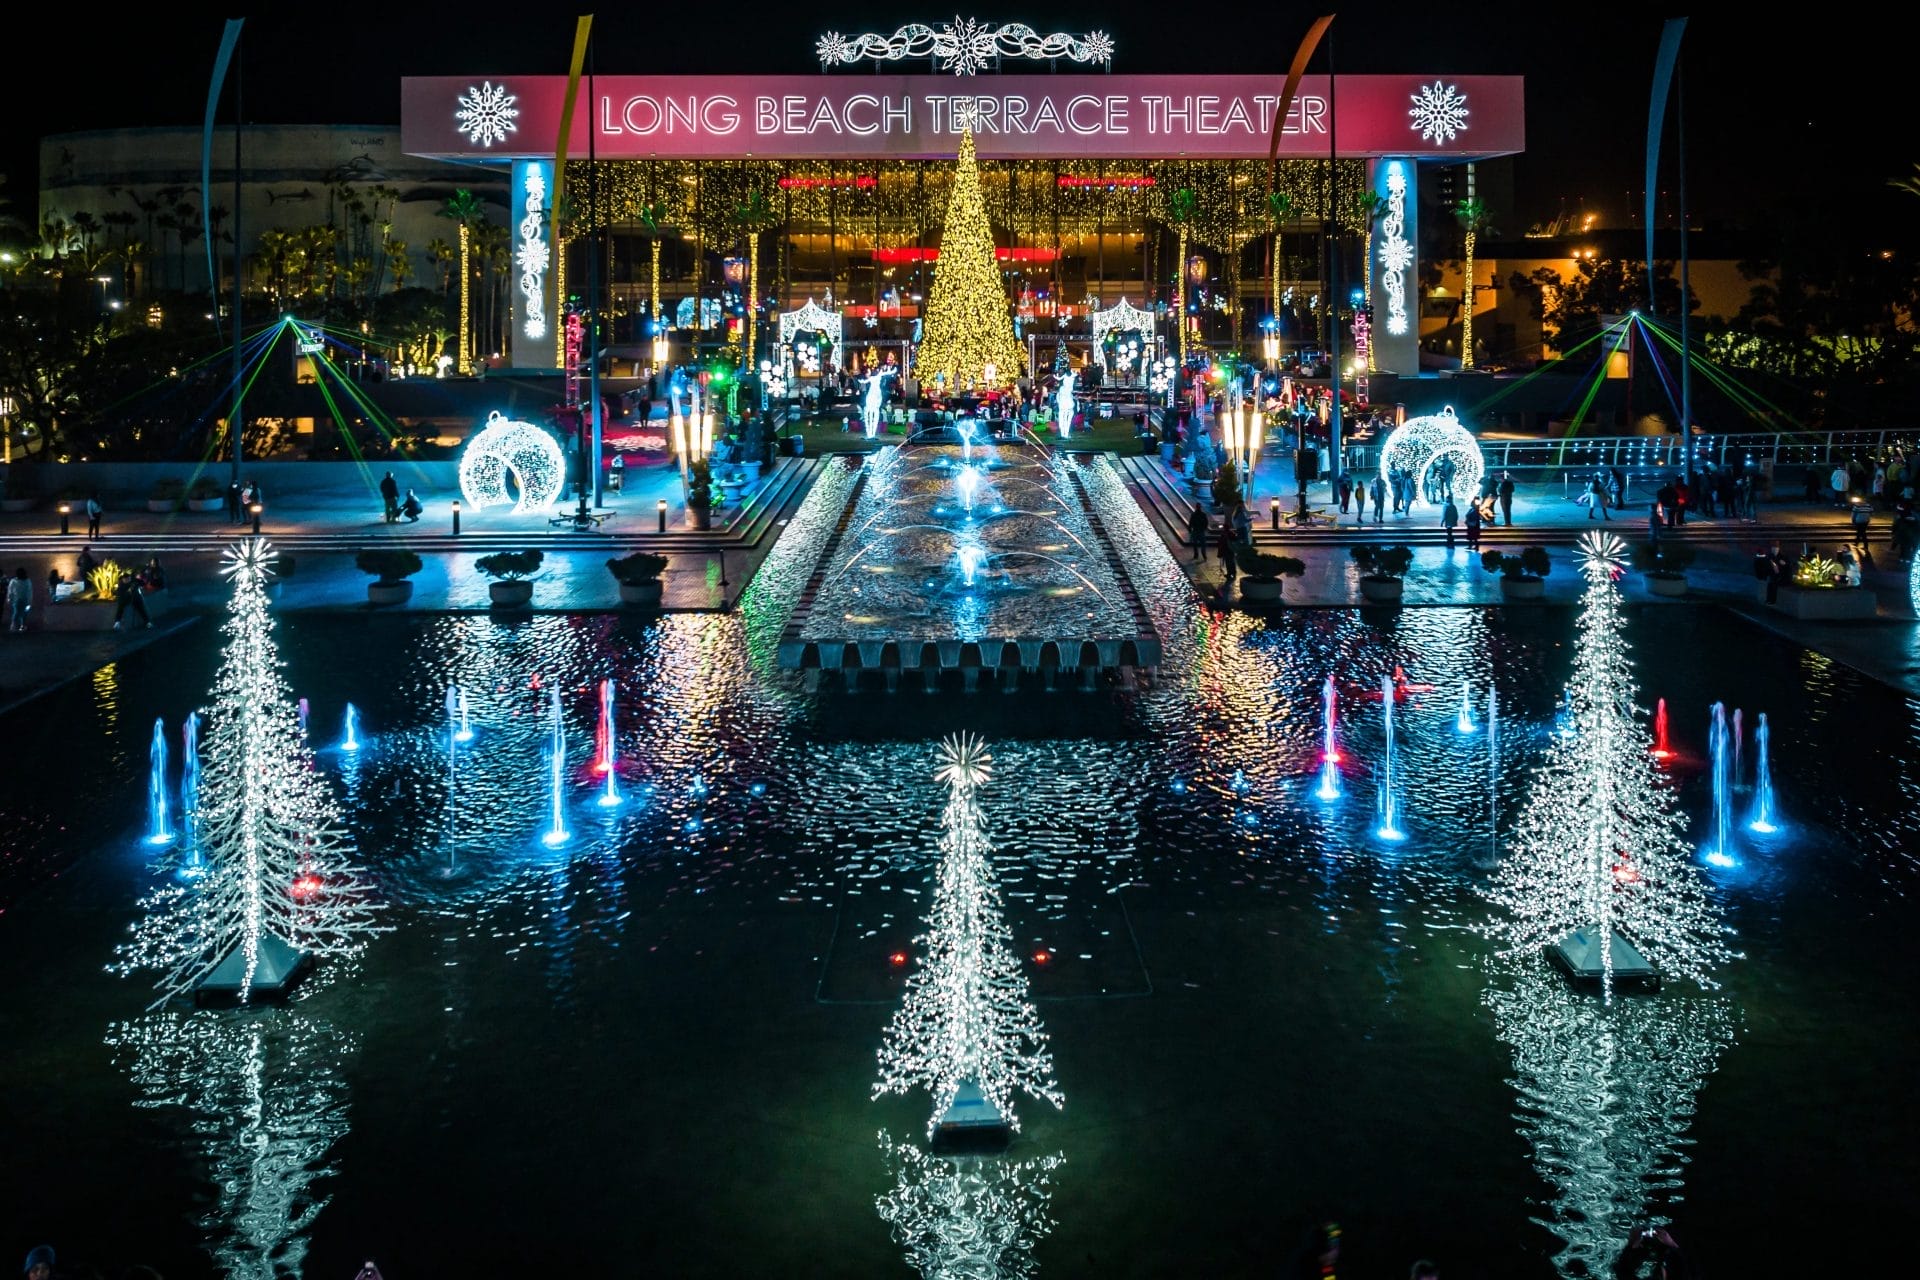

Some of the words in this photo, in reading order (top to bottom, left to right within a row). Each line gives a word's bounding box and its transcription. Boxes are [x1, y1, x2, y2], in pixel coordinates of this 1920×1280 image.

[601, 95, 741, 135] LONG
[755, 95, 912, 135] BEACH
[925, 95, 1130, 134] TERRACE
[1141, 95, 1328, 134] THEATER
